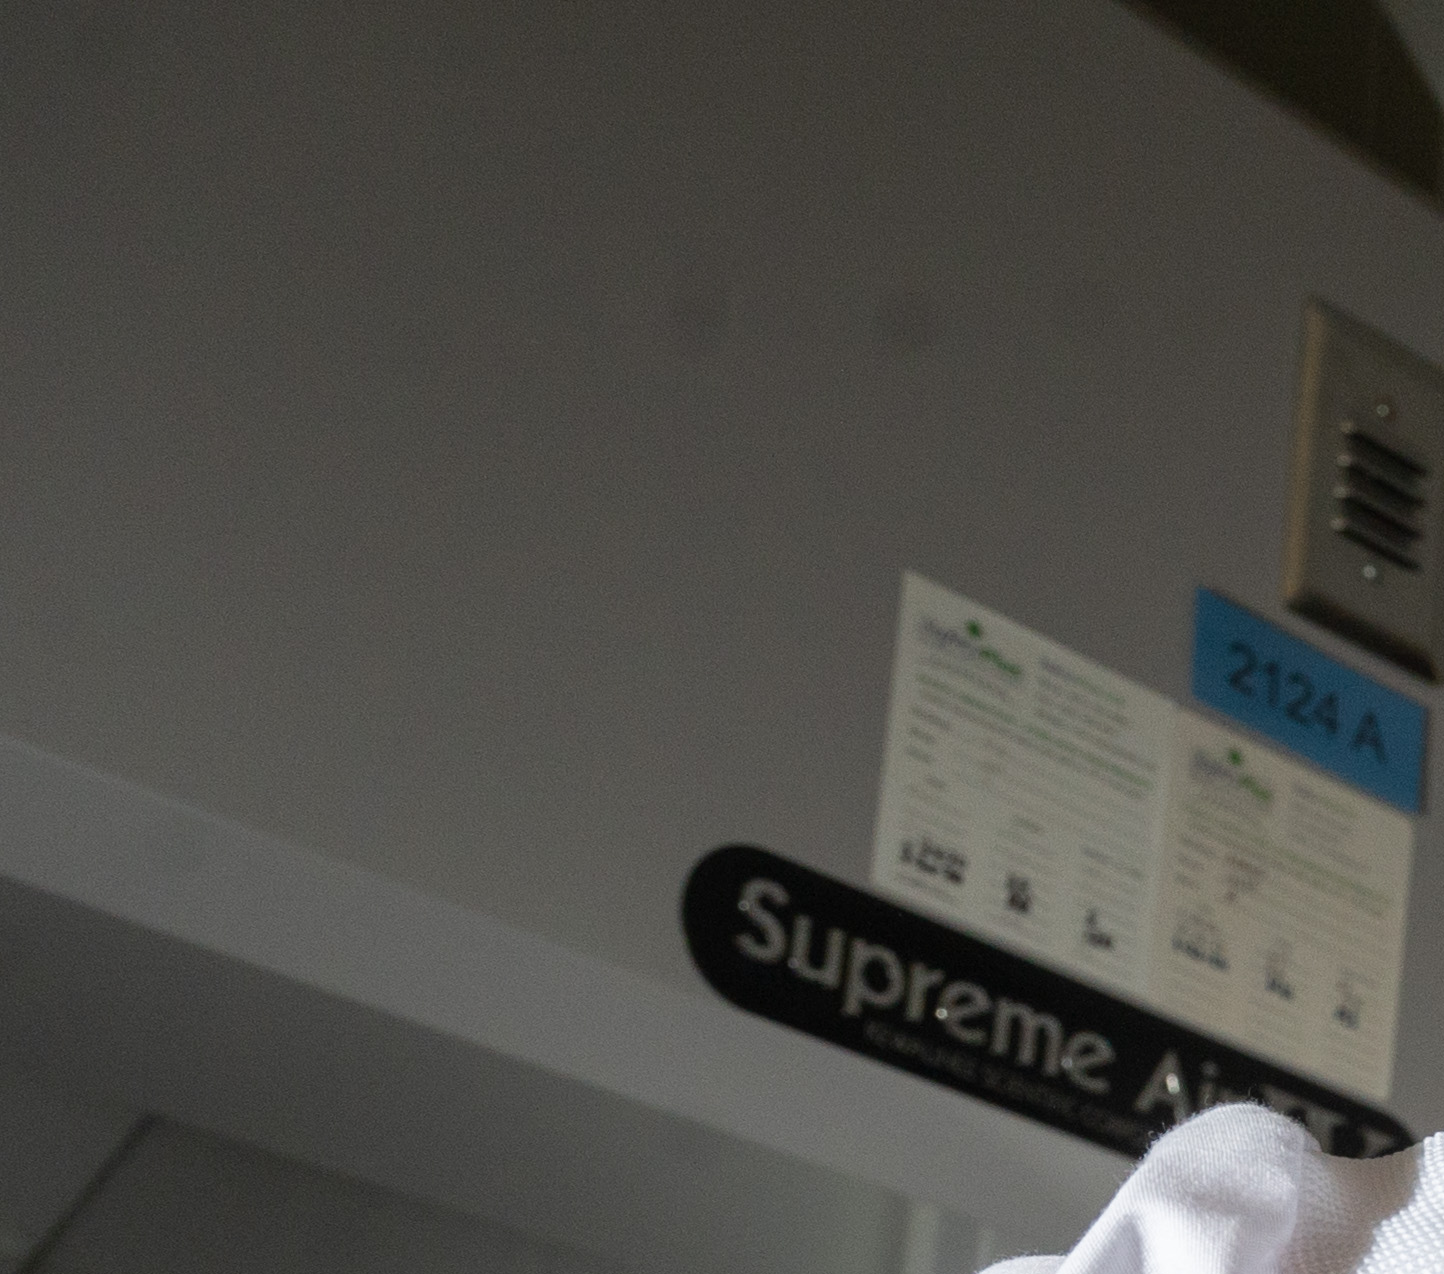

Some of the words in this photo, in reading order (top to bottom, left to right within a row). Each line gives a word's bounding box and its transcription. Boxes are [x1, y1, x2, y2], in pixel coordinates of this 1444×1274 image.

[1228, 640, 1340, 735] 2124
[1352, 711, 1387, 766] A
[735, 877, 1115, 1094] Supreme
